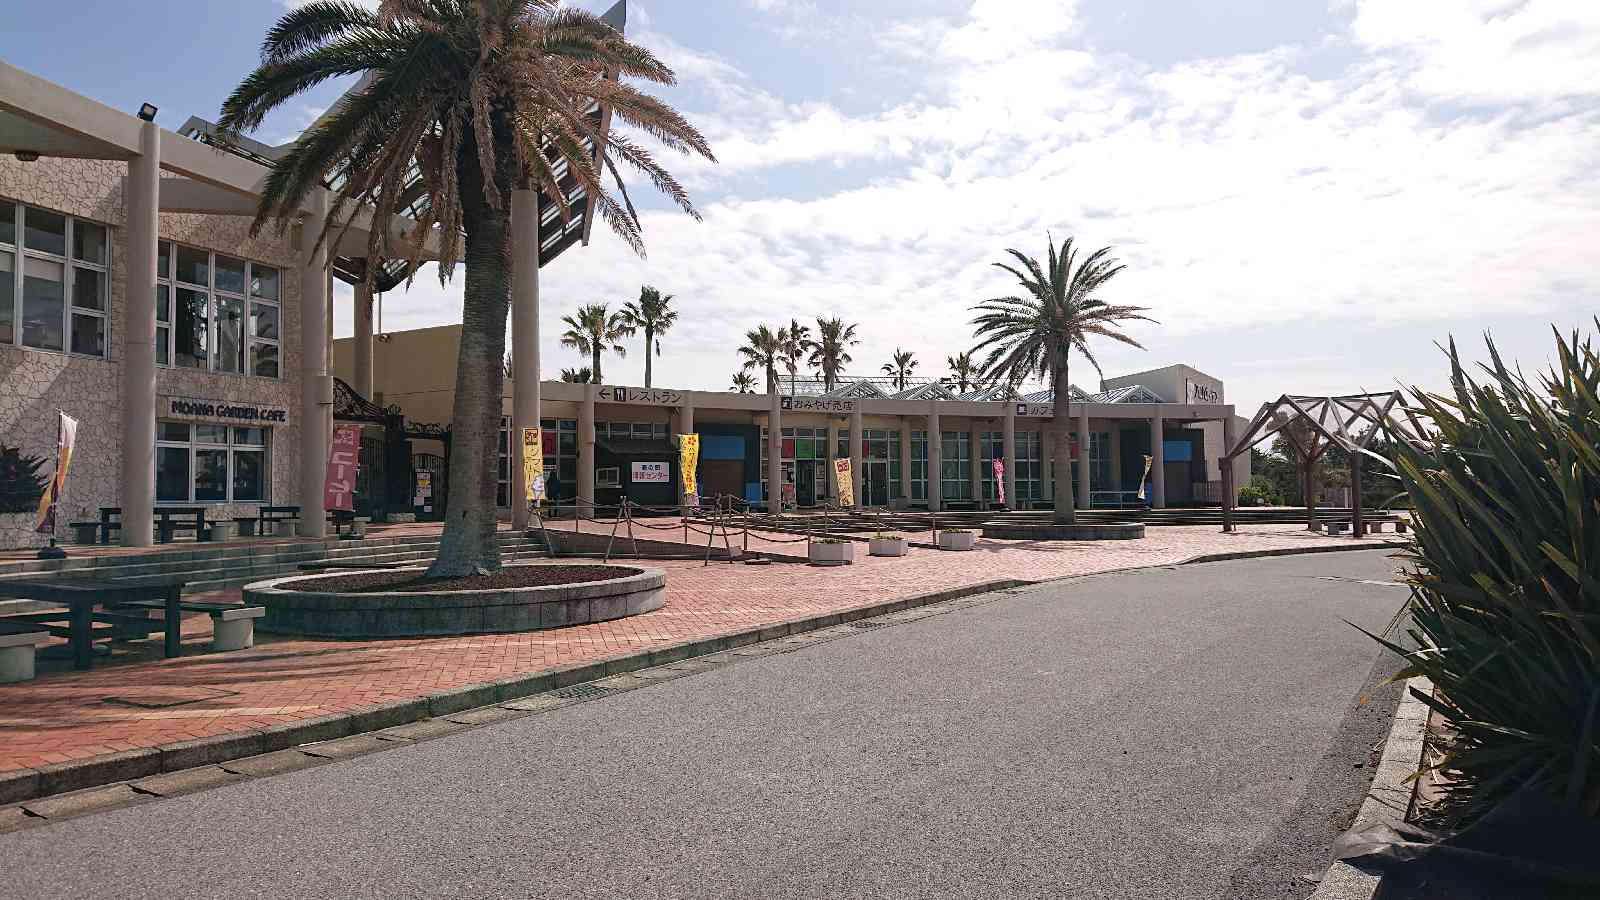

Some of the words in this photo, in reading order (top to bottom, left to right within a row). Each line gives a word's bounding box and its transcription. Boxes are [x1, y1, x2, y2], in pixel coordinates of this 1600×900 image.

[629, 388, 682, 404] レストラン
[216, 405, 258, 420] GARDEN
[792, 399, 854, 411] おみやげ売店
